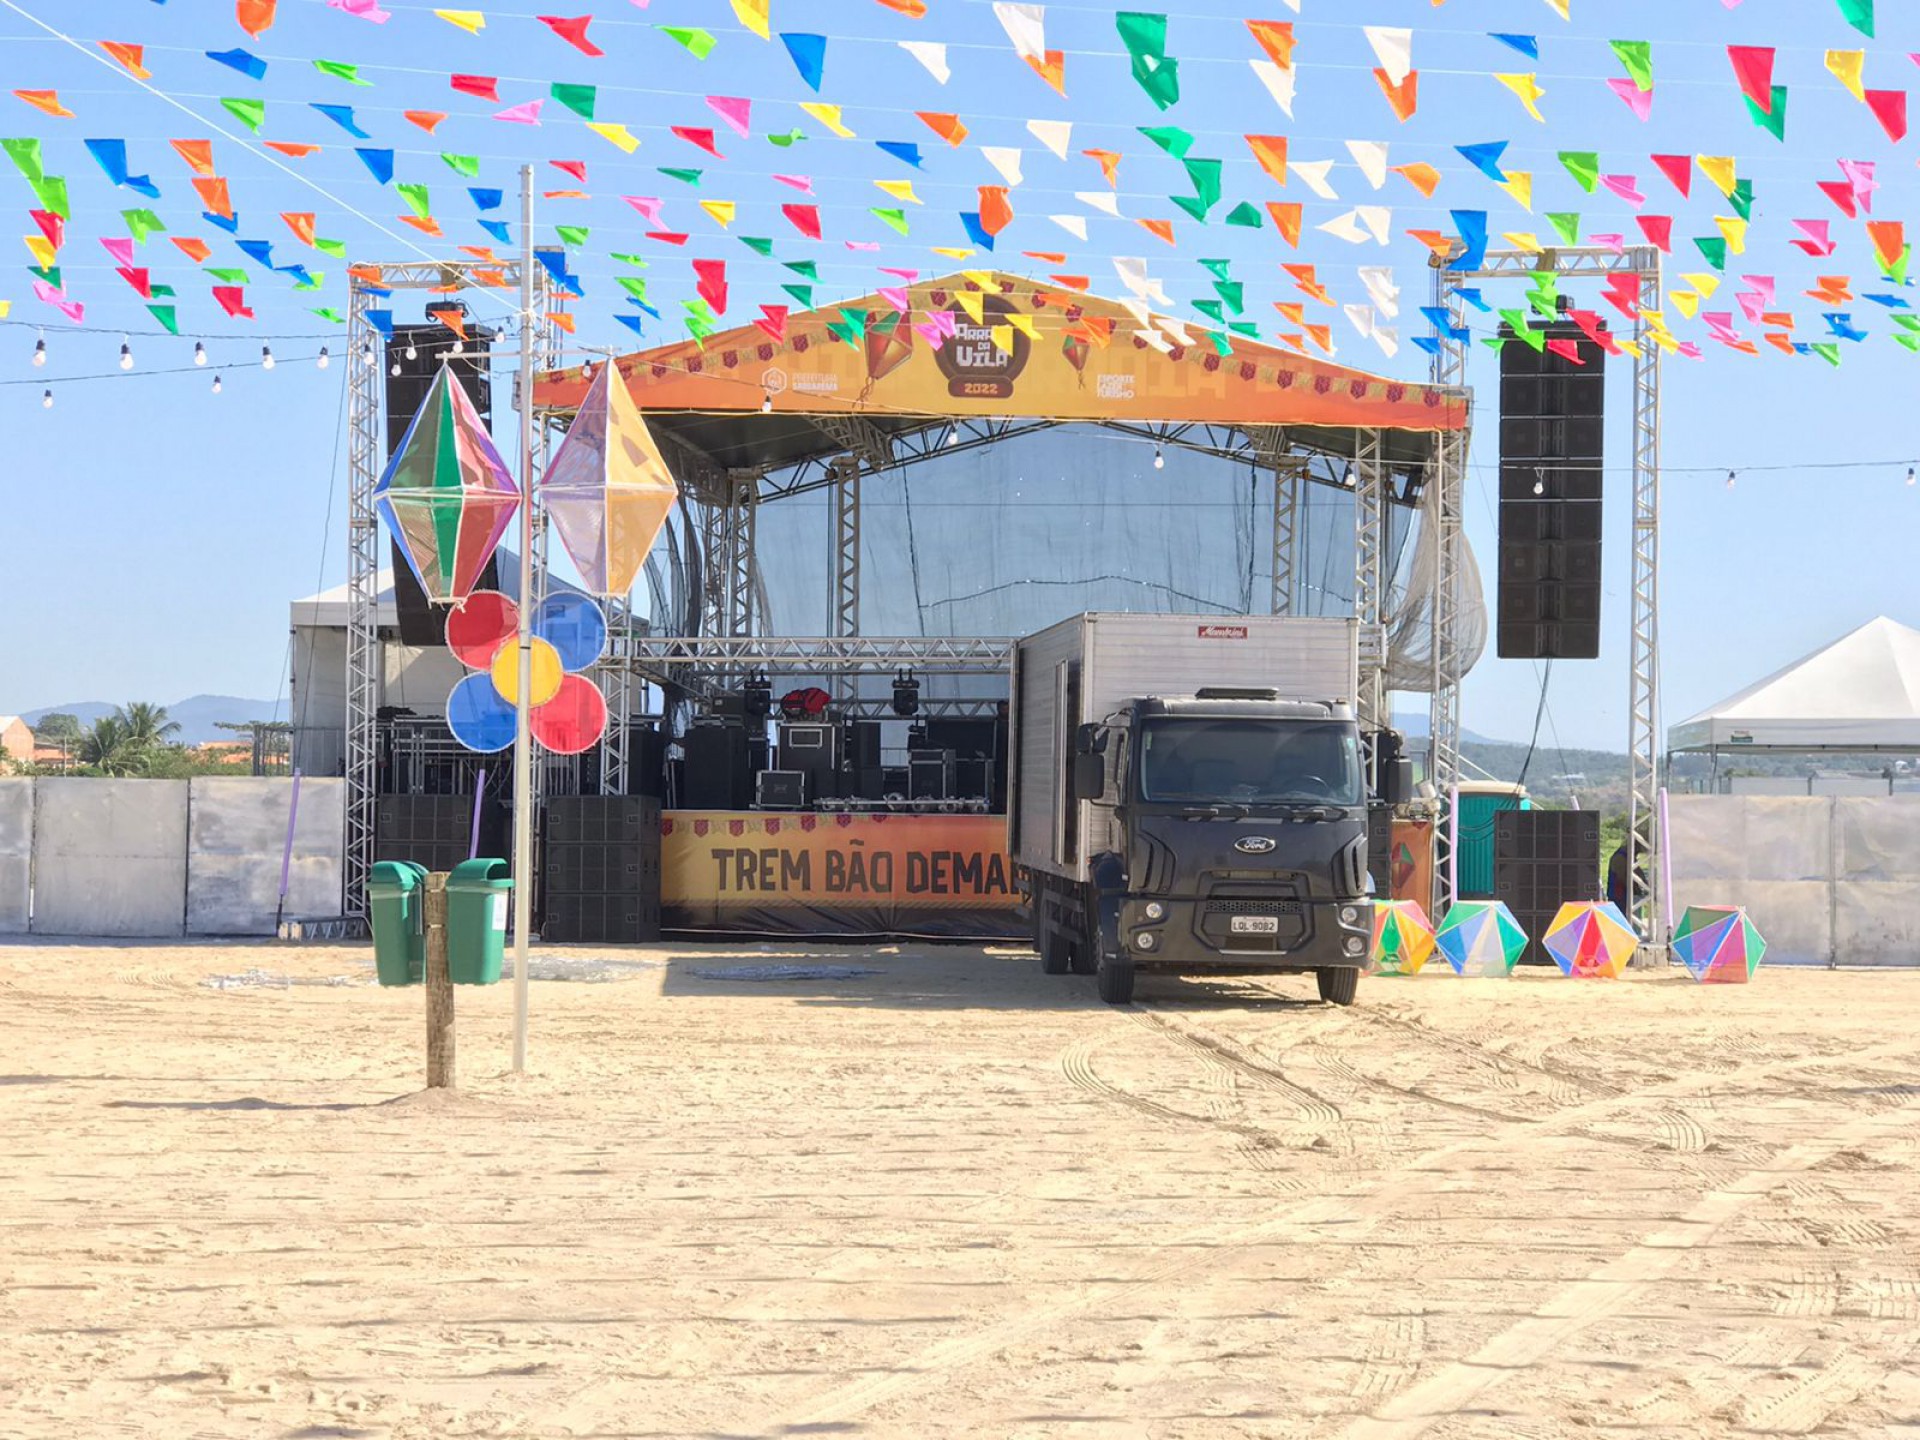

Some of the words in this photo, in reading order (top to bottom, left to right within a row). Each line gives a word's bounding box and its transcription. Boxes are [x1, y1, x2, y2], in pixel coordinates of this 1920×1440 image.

[978, 342, 990, 350] DA
[964, 383, 998, 394] 2022
[712, 848, 811, 891] TREM
[825, 839, 893, 893] BÃO
